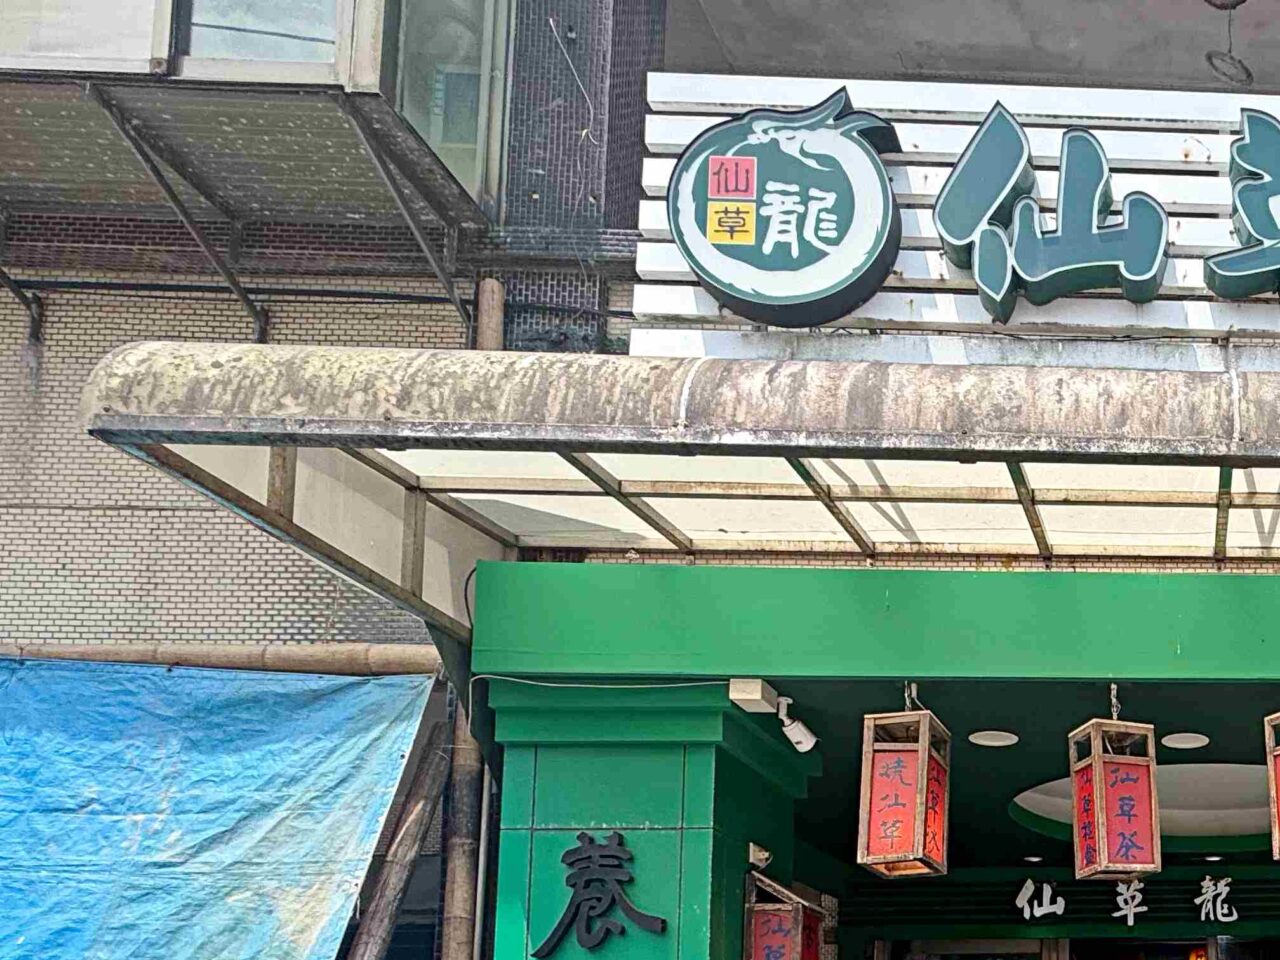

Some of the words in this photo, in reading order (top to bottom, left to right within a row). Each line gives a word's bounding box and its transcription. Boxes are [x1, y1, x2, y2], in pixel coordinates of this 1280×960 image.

[712, 161, 751, 239] 仙草
[761, 182, 838, 259] 龍
[1016, 875, 1239, 926] 仙草龍
